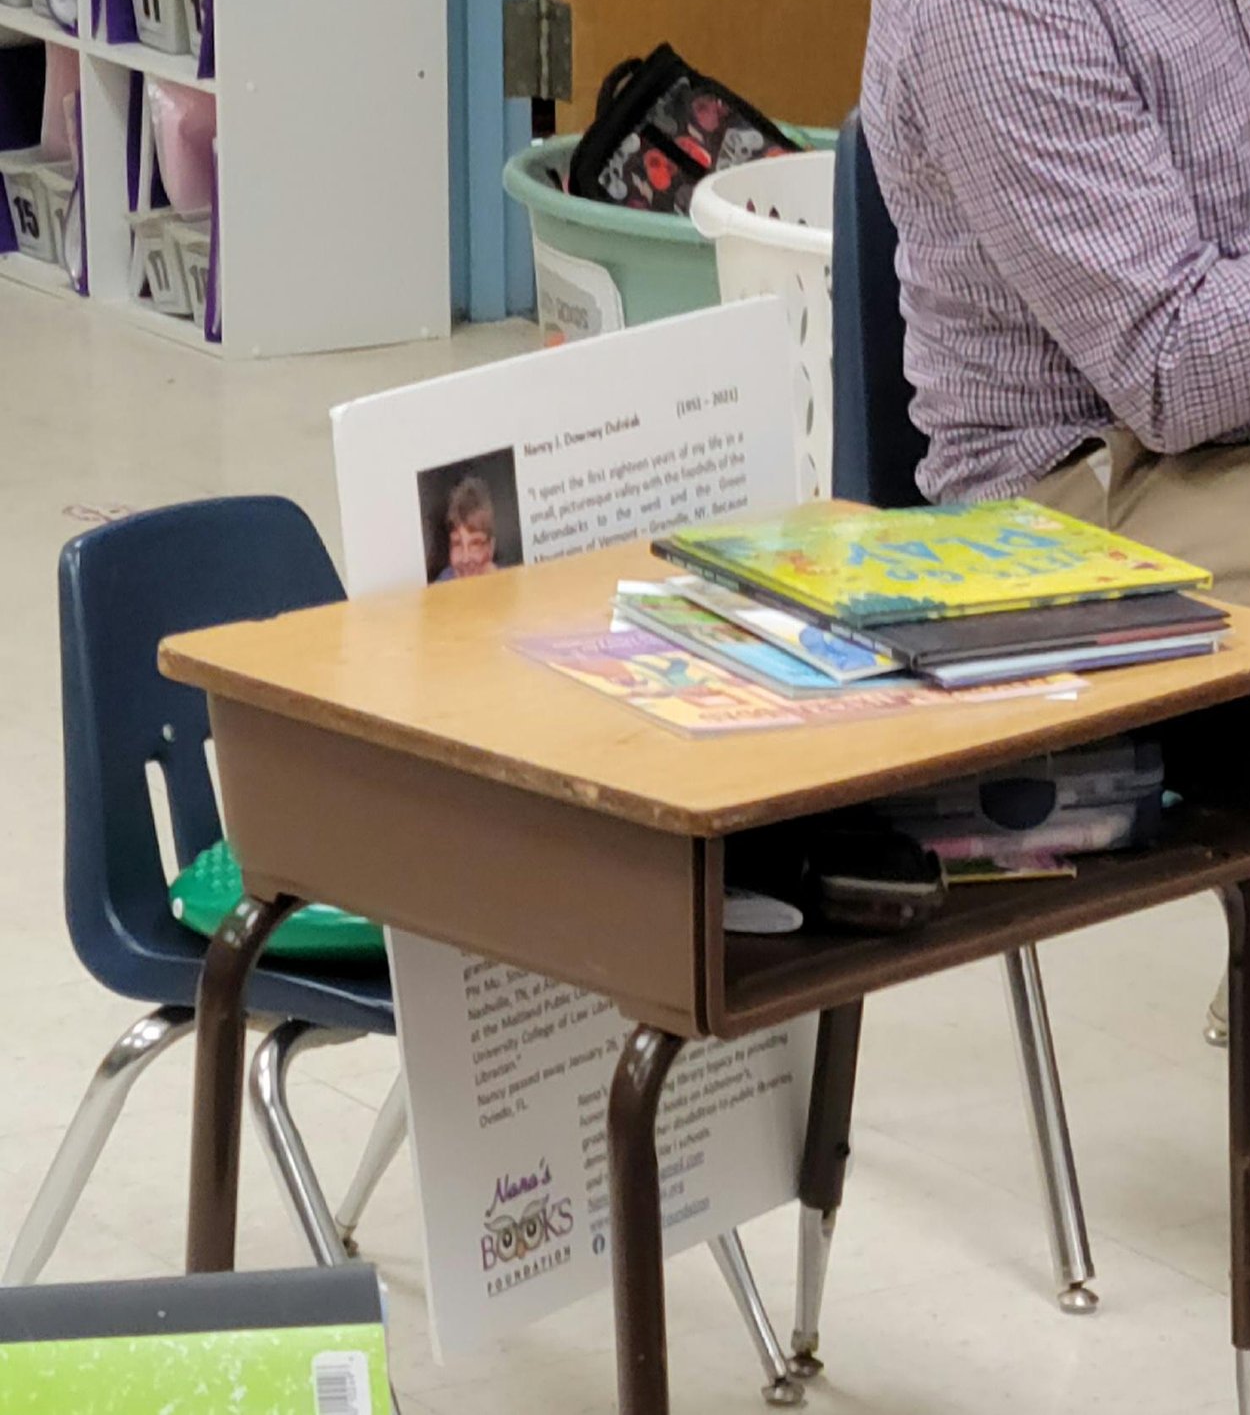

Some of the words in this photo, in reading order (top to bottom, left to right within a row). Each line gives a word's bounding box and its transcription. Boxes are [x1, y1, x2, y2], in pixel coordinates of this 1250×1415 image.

[13, 195, 40, 240] 15
[524, 441, 553, 457] Nancy
[564, 426, 603, 447] Downey
[485, 1156, 552, 1217] Nana's
[487, 1245, 571, 1297] FOUNDATION
